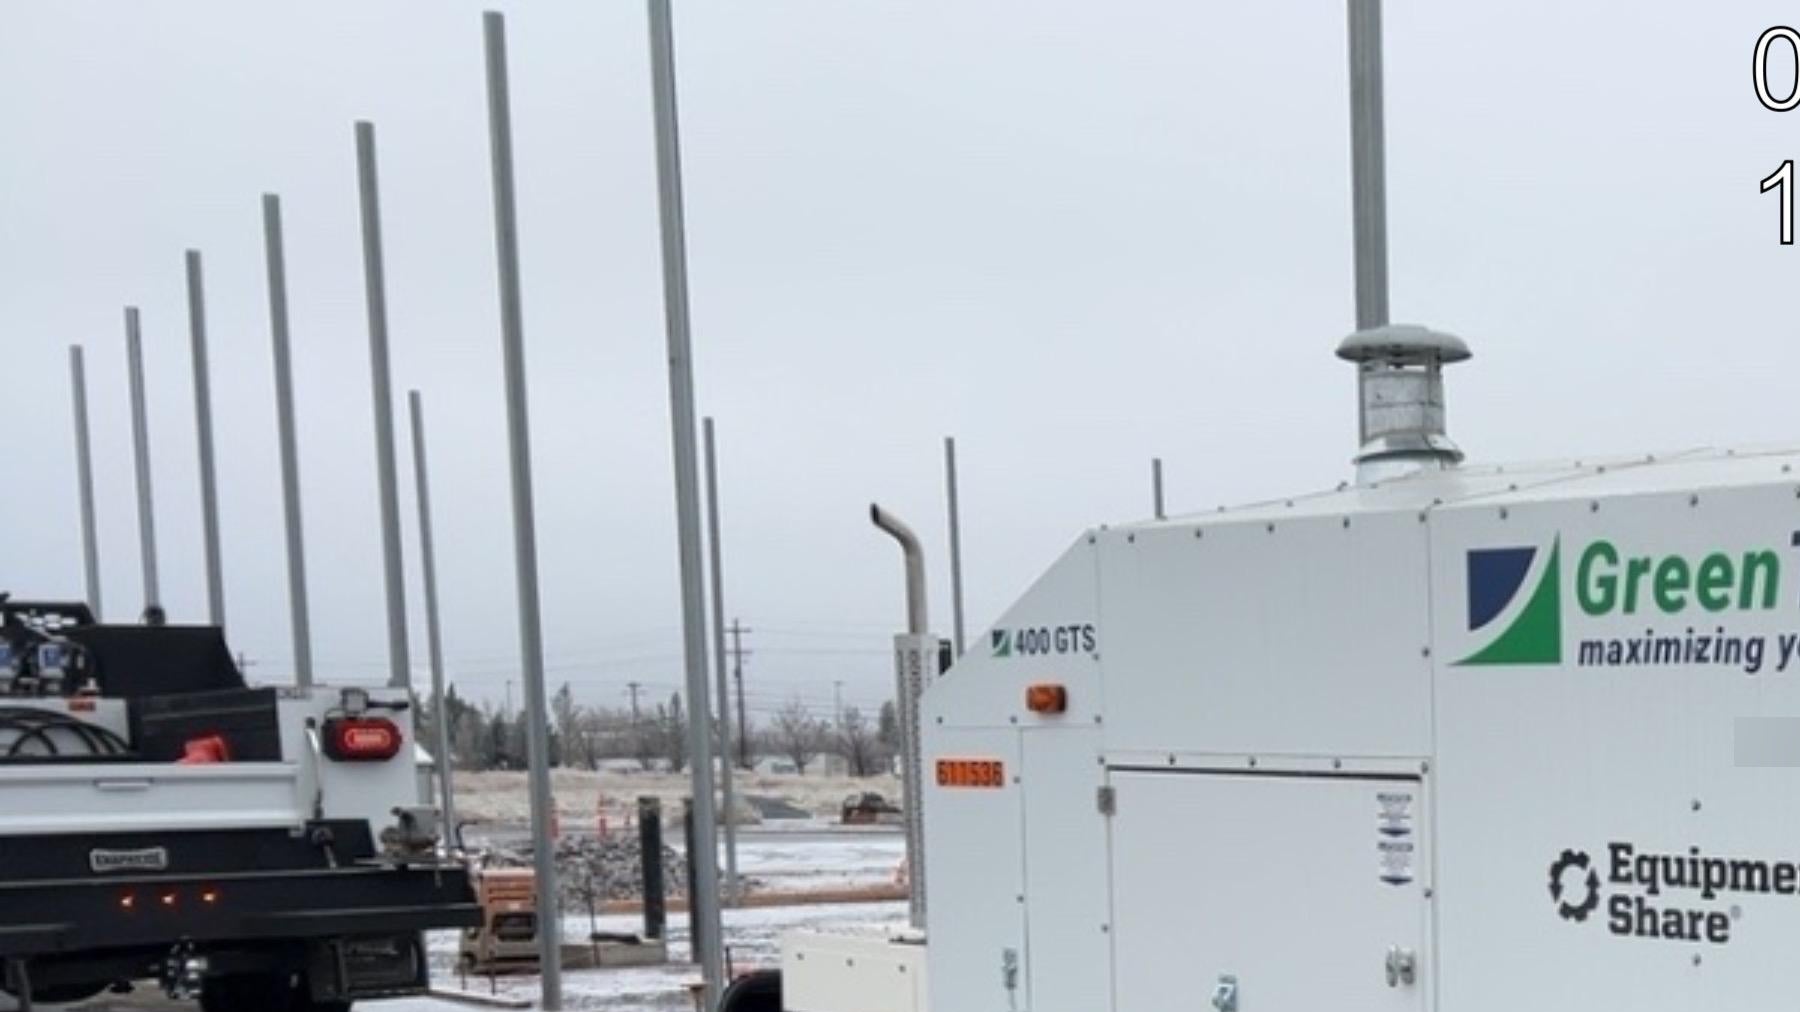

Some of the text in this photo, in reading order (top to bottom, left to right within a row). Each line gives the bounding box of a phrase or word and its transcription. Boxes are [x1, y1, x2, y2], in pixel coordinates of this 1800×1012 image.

[1016, 624, 1096, 655] 400 GTS
[1578, 626, 1765, 672] maximizing
